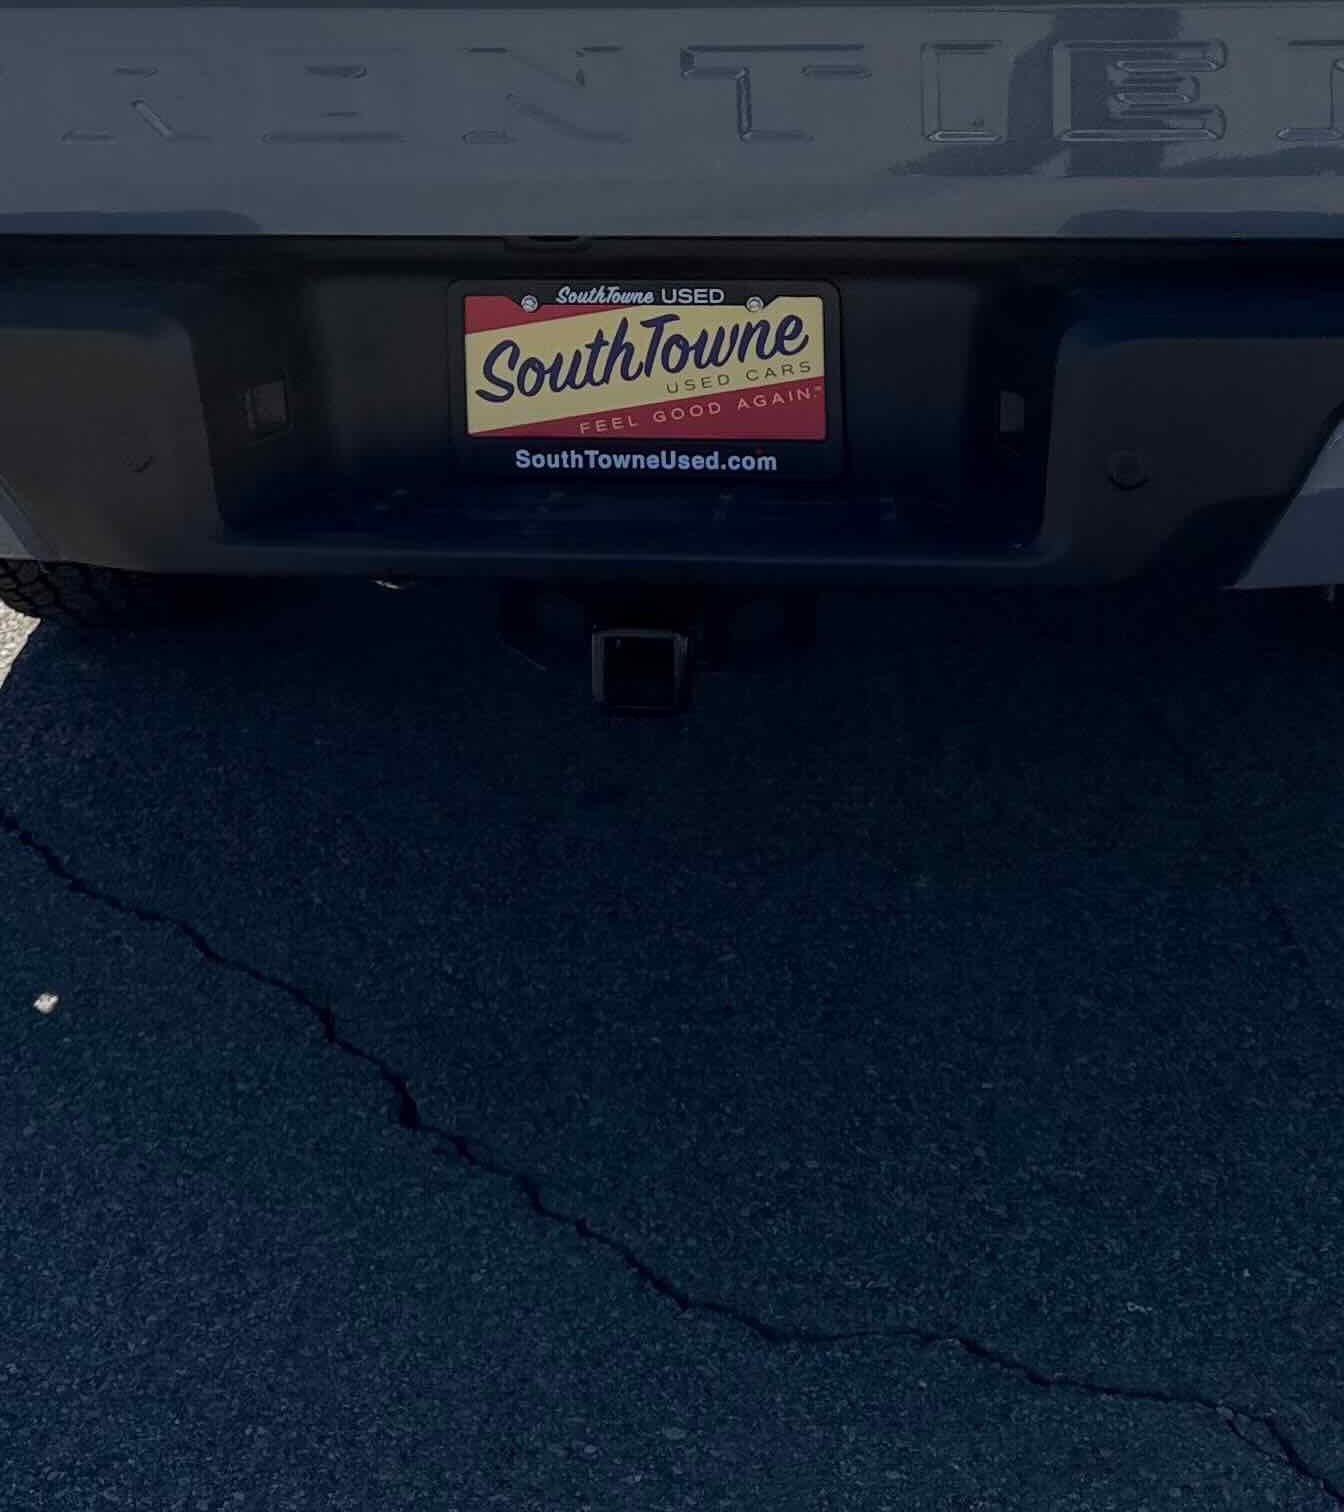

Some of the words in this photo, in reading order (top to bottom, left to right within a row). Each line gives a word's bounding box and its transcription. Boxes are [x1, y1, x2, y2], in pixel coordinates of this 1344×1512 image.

[555, 285, 655, 306] SouthTowne
[661, 288, 725, 305] USED
[475, 313, 810, 404] SouthTowne
[665, 372, 731, 395] USED
[744, 360, 812, 383] CARS
[579, 414, 640, 435] FEEL
[653, 400, 722, 424] GOOD
[514, 448, 778, 472] SouthTowneUsed.com
